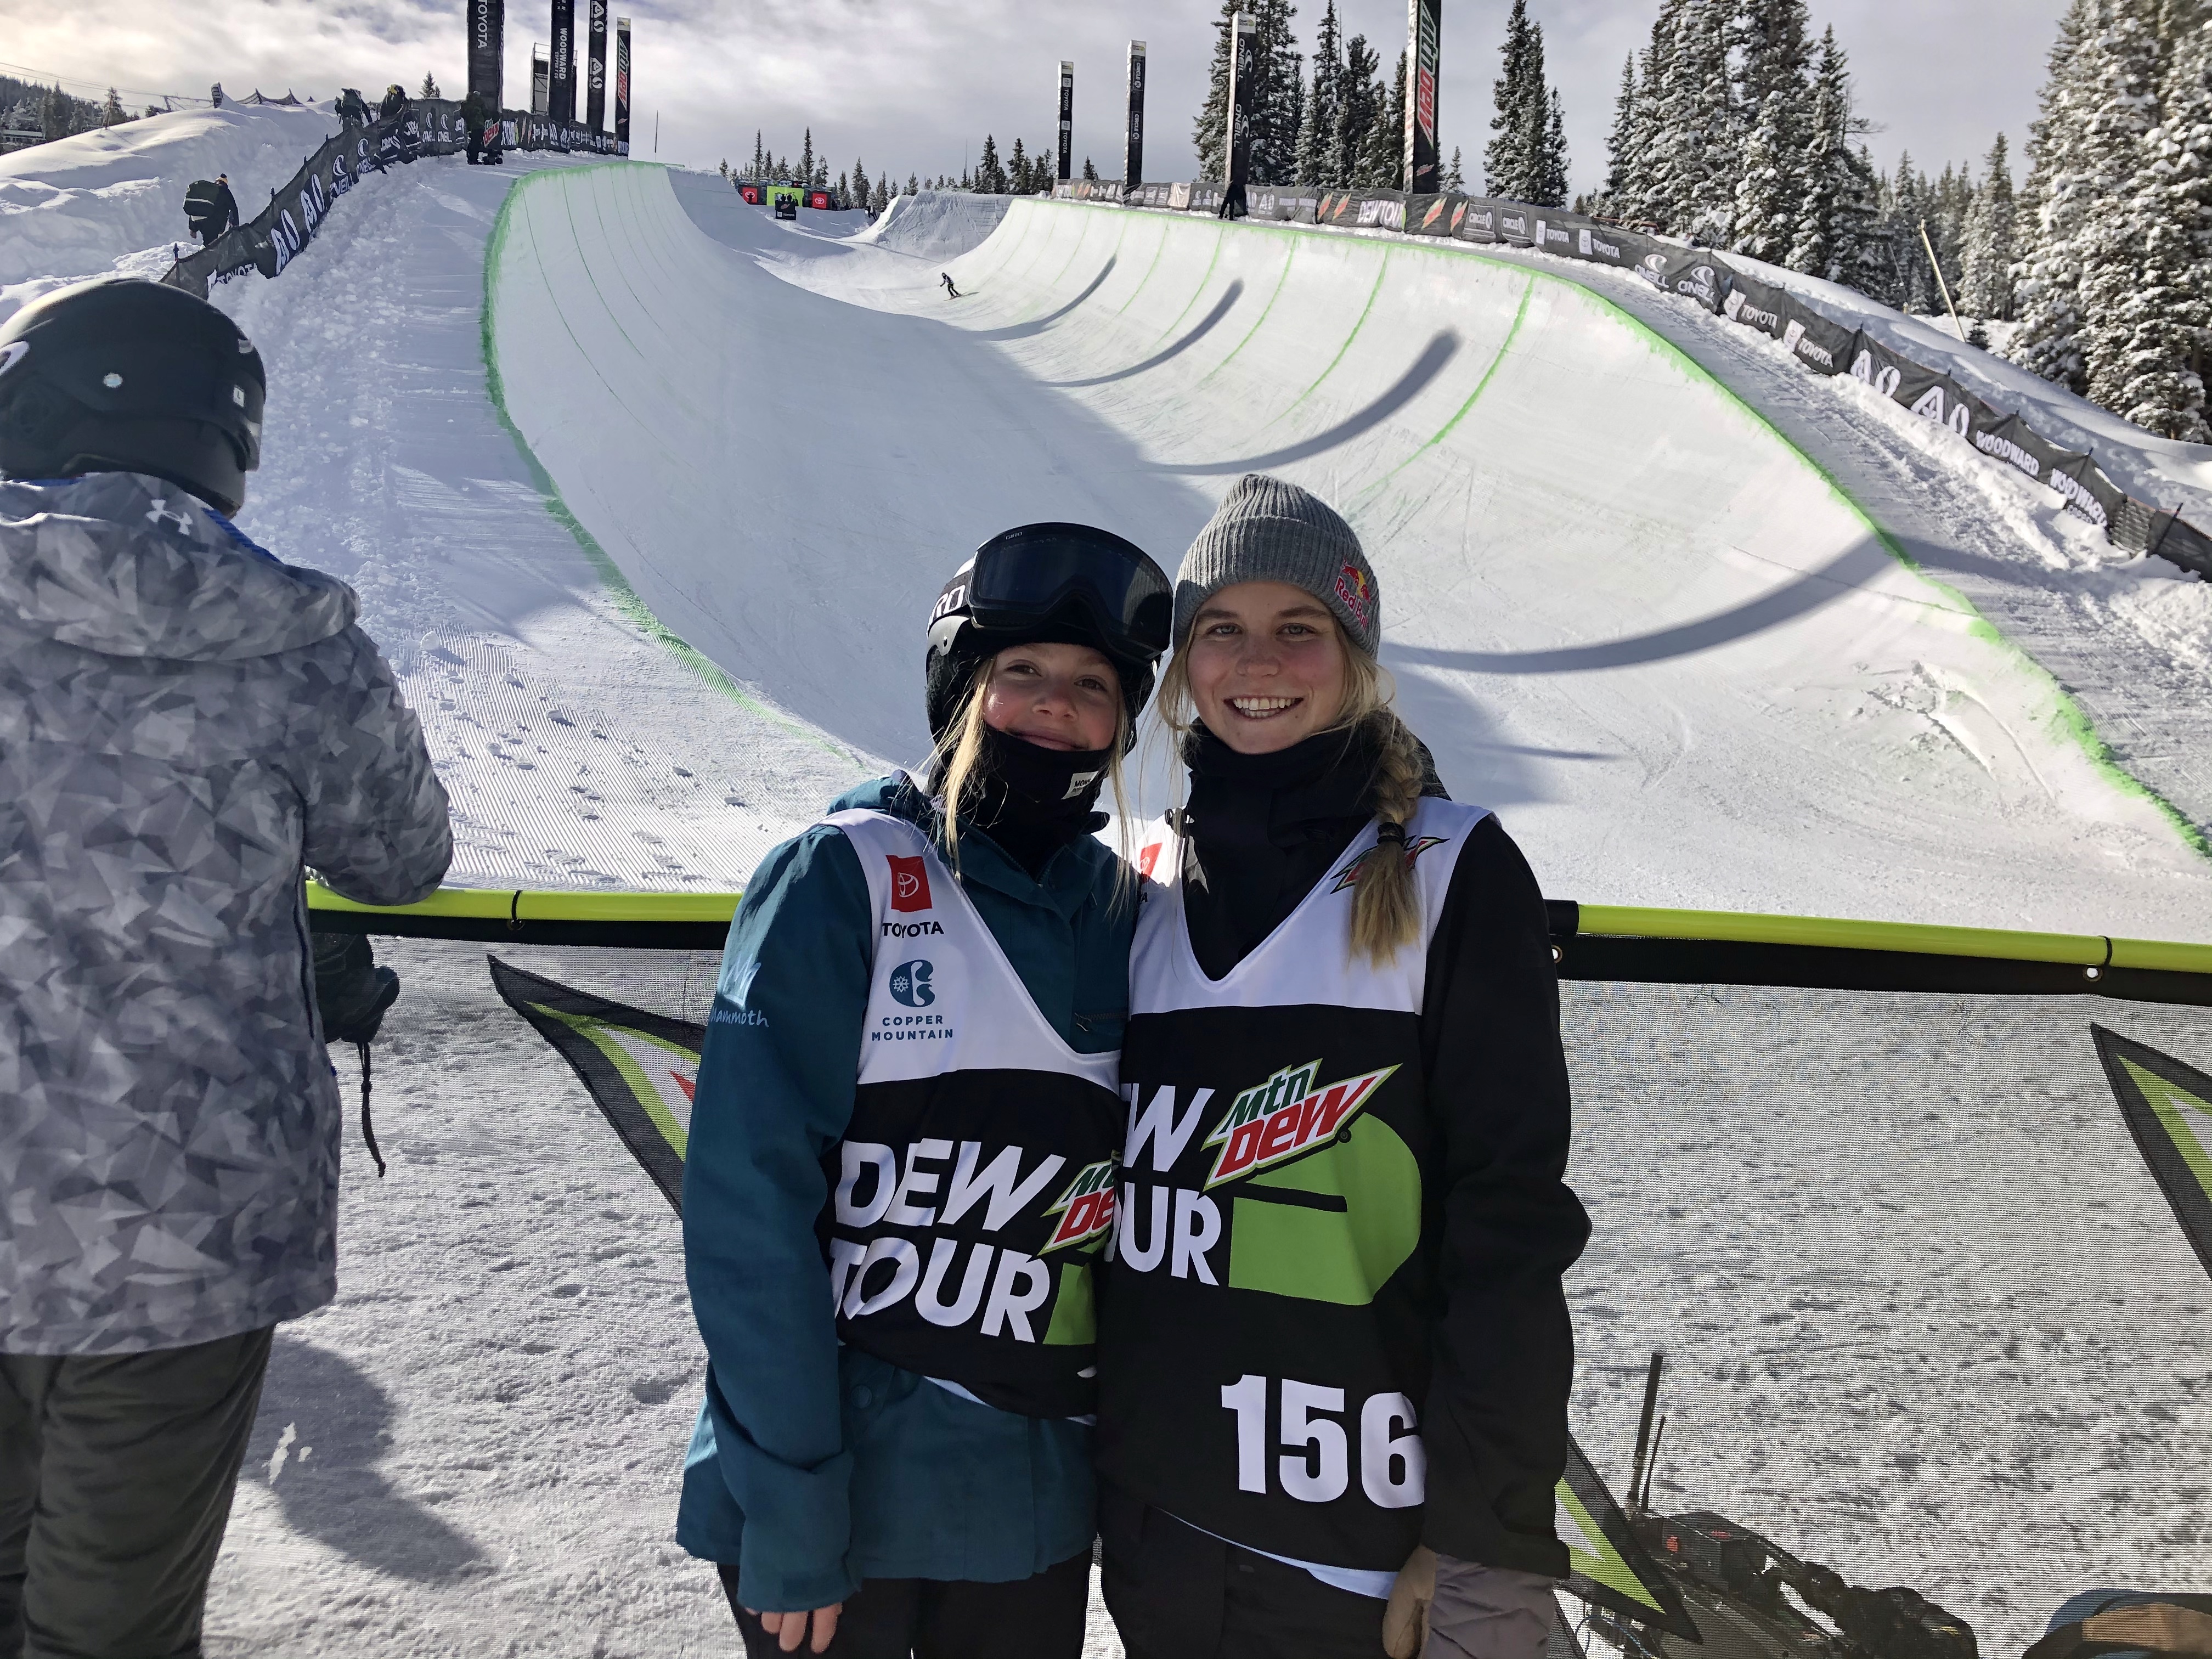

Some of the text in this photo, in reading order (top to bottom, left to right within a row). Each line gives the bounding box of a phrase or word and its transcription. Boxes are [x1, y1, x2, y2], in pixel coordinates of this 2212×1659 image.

[477, 0, 488, 49] TOYOTA
[559, 27, 567, 80] WOODWARD
[1546, 228, 1570, 243] TOYOTA
[1592, 238, 1621, 259] TOYOTA
[1798, 337, 1833, 368] TOYOTA
[1976, 430, 2040, 477] WOODWARD
[1005, 531, 1023, 540] GIRO
[1334, 575, 1357, 612] Red
[882, 921, 945, 939] TOYOTA
[871, 1029, 953, 1042] MOUNTAIN
[882, 1015, 944, 1026] COPPER
[834, 1137, 1067, 1232] DEW
[829, 1237, 1050, 1344] TOUR
[1220, 1373, 1427, 1509] 156
